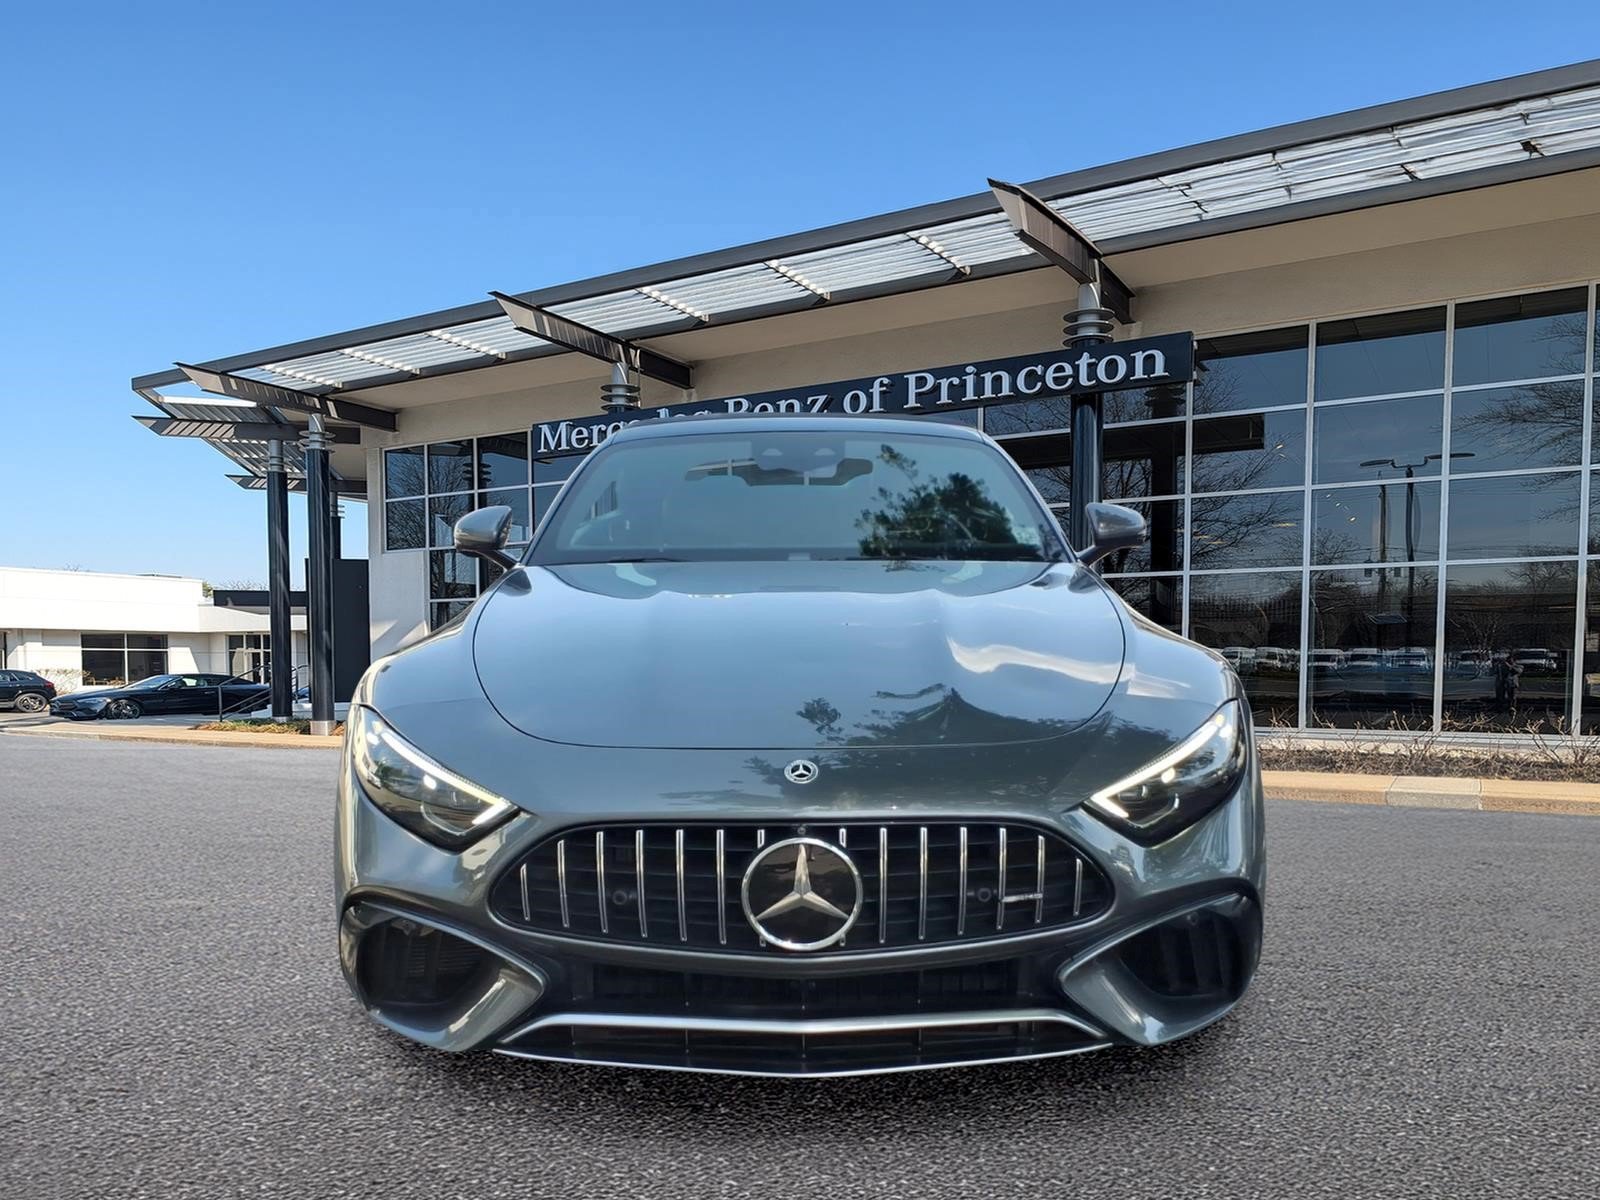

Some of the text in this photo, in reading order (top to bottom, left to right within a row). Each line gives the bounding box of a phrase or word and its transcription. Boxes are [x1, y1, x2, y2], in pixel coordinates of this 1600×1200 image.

[537, 408, 712, 453] Merc
[843, 377, 890, 415] of
[903, 349, 1169, 408] Princeton
